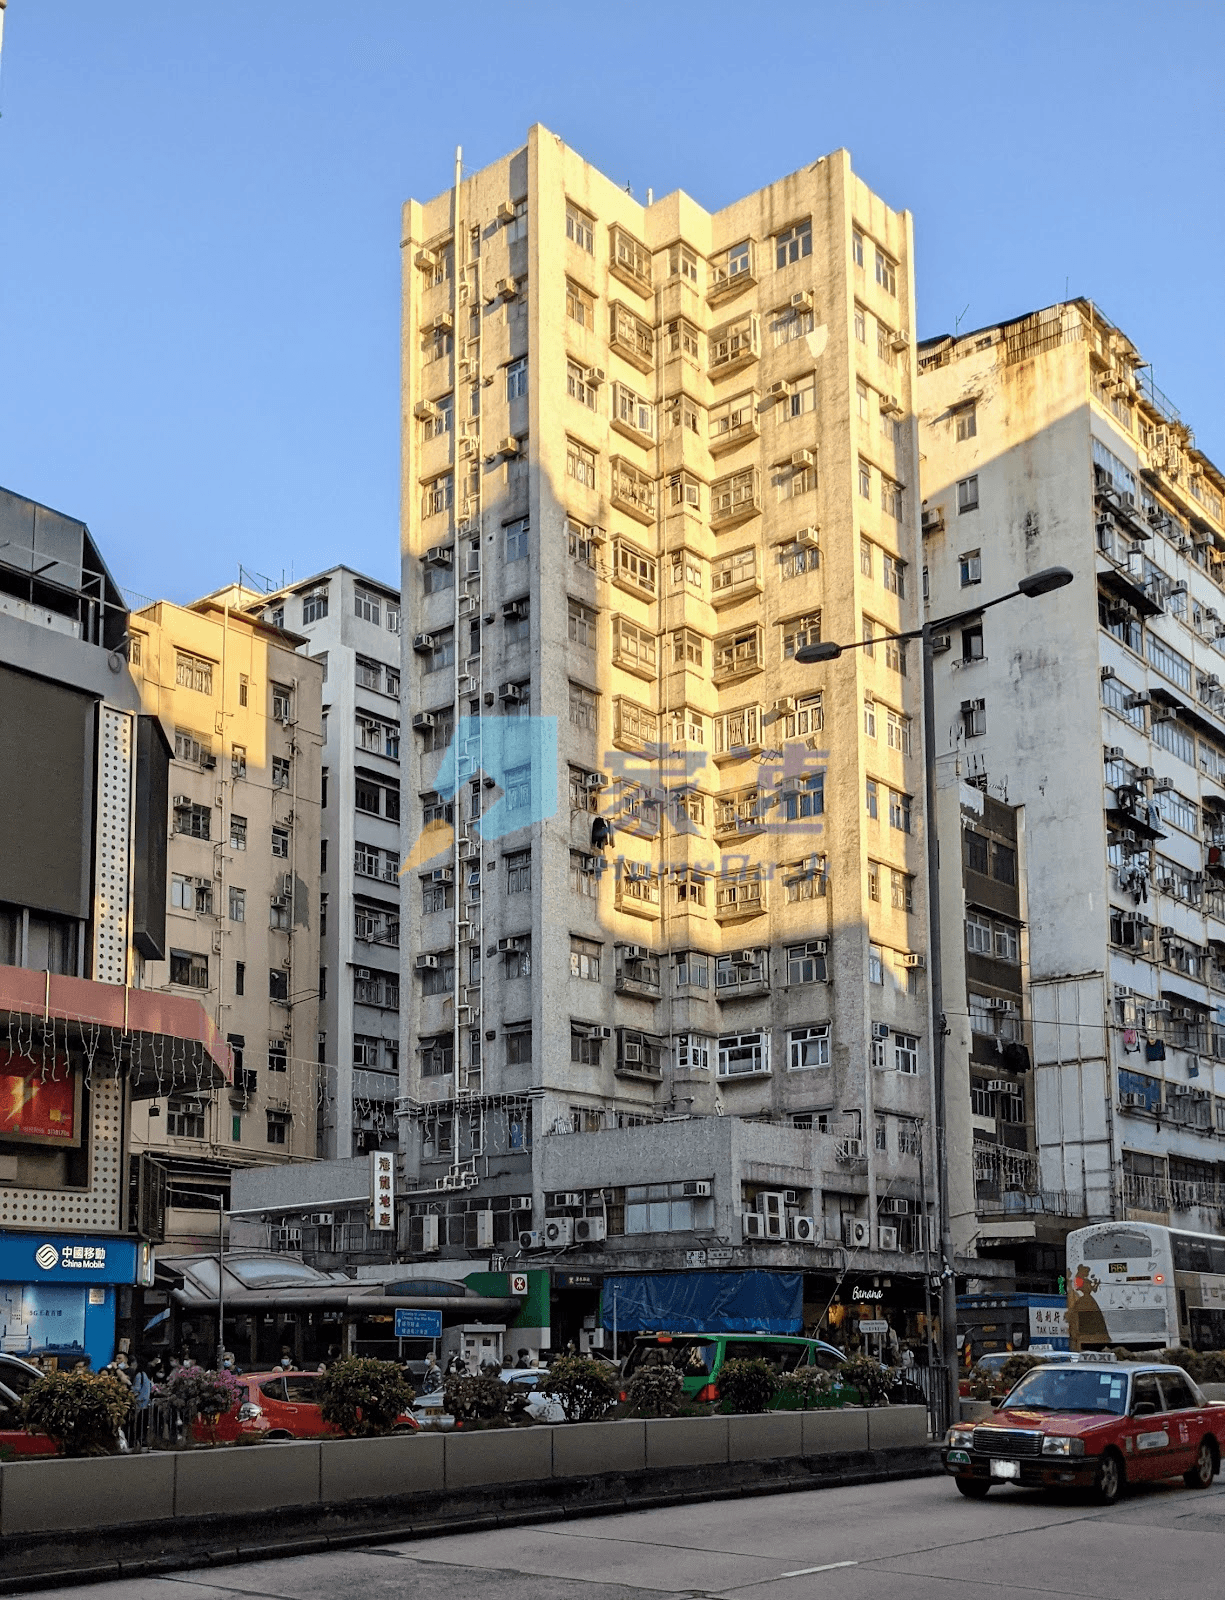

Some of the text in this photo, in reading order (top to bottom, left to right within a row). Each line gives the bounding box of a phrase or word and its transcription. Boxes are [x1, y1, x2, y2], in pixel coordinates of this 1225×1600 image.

[62, 1246, 106, 1260] 中國移動
[61, 1259, 105, 1269] China Mobile
[852, 1285, 884, 1301] Banana
[1081, 1353, 1112, 1361] TAXI
